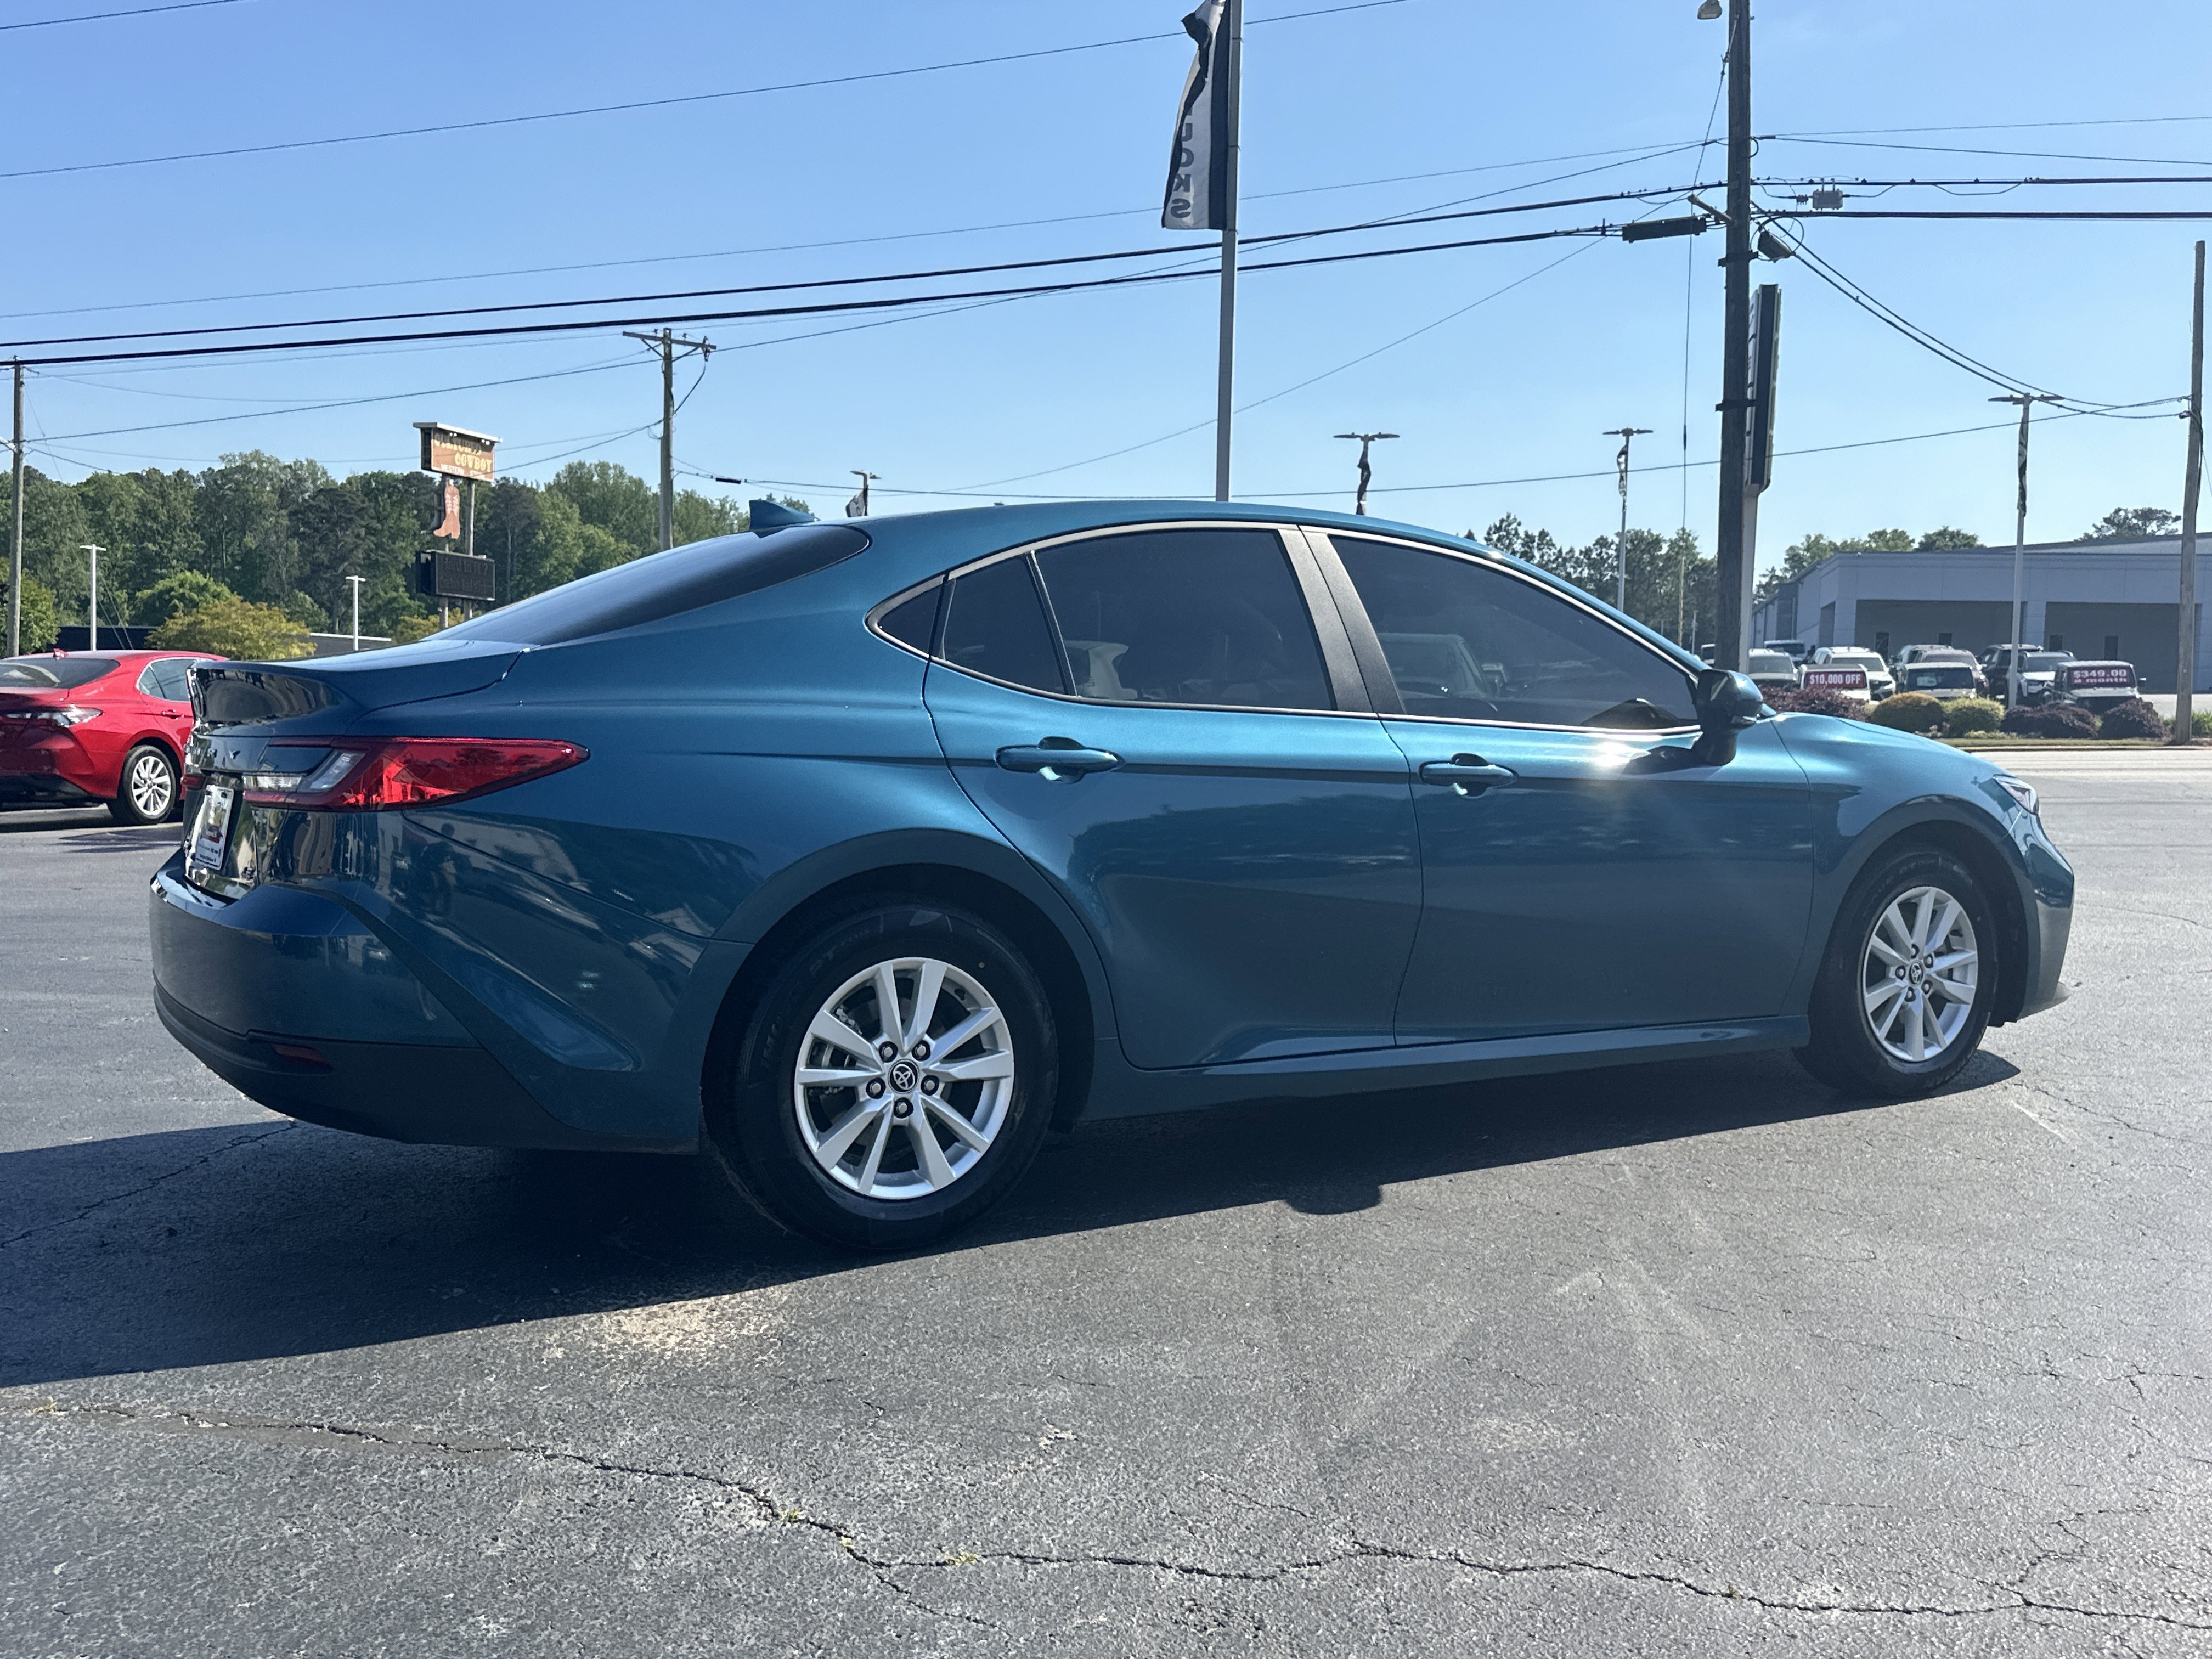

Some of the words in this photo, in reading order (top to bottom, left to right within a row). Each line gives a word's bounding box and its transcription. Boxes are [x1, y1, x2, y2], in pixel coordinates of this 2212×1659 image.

[455, 452, 492, 472] COWBOY
[2073, 669, 2127, 678] $349.00
[1809, 674, 1843, 685] $10,000
[1845, 674, 1861, 684] OFF
